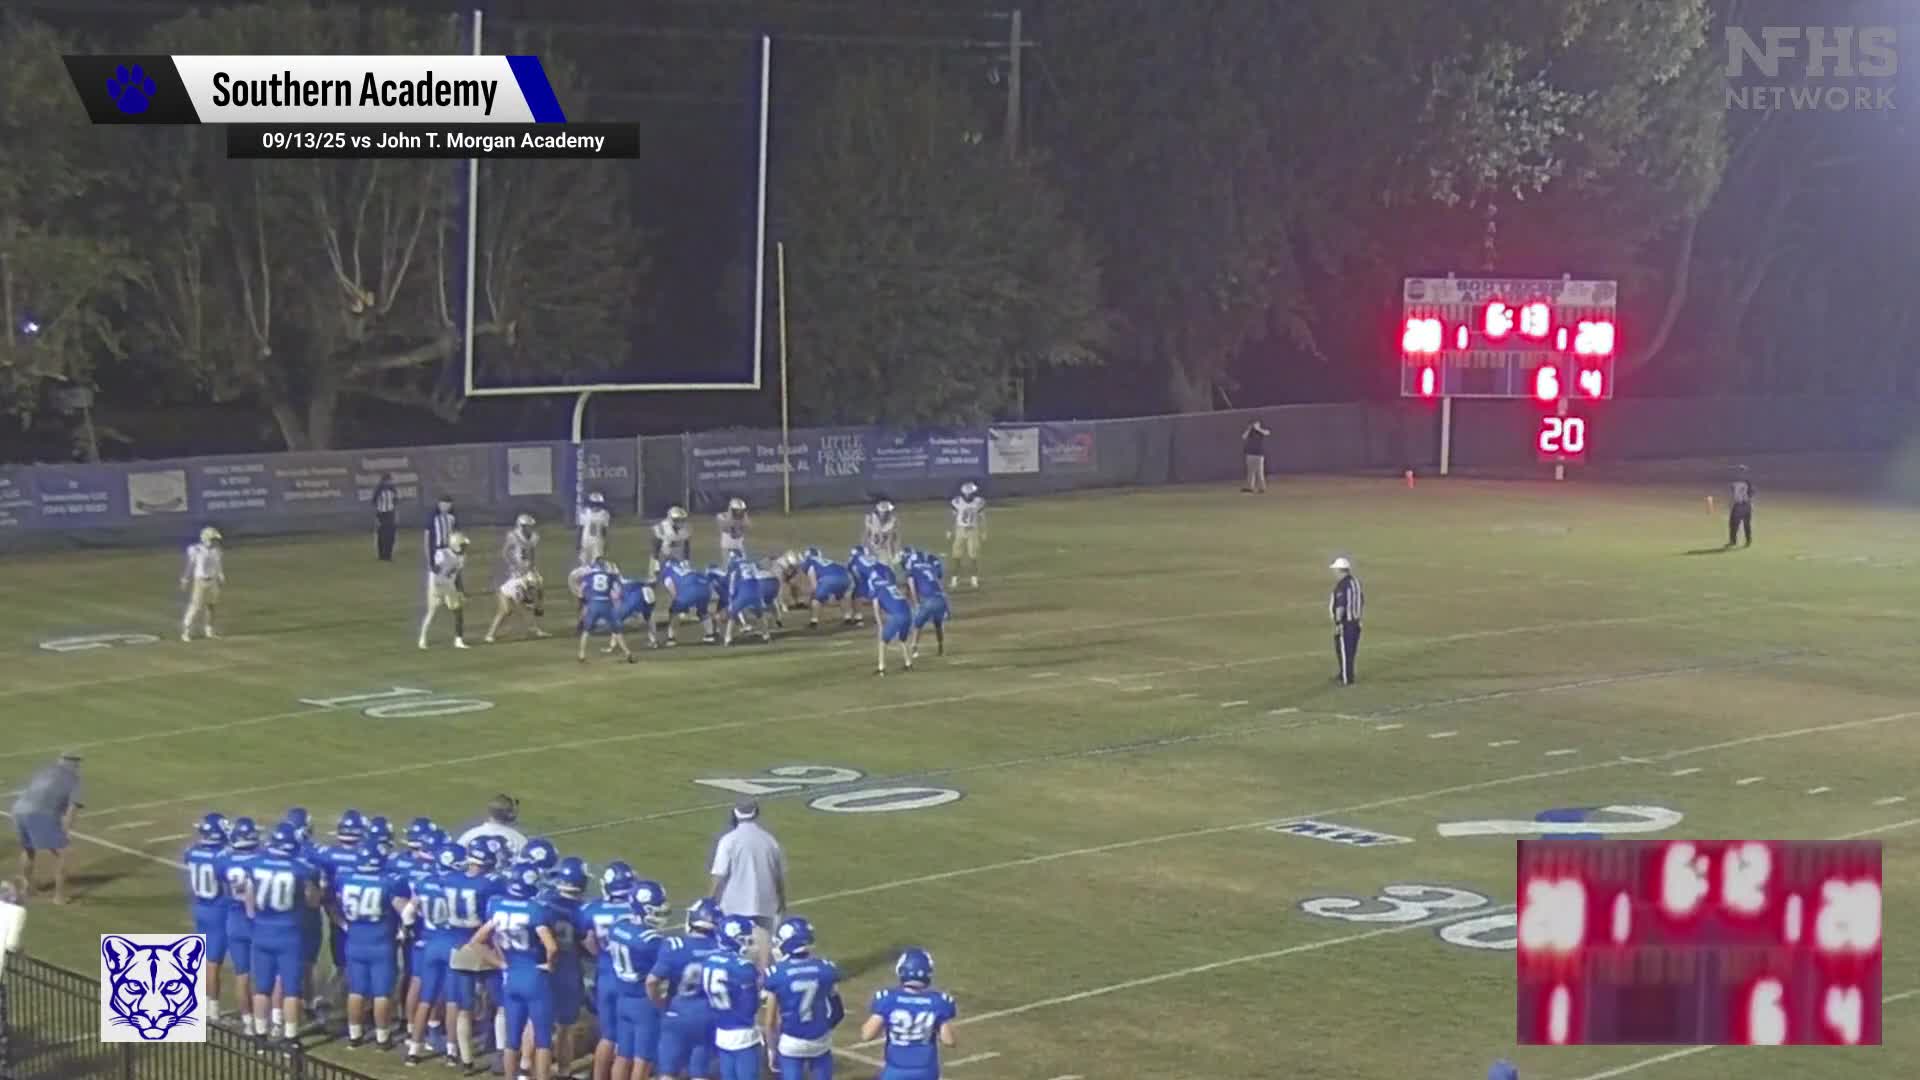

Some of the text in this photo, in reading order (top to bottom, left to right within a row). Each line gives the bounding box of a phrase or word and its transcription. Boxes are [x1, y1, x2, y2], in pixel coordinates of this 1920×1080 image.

[1537, 367, 1558, 399] 6
[1581, 370, 1601, 396] 4
[1540, 417, 1584, 452] 20
[302, 686, 494, 718] 10
[693, 766, 961, 813] 20
[252, 867, 294, 911] 70
[790, 979, 819, 1022] 7
